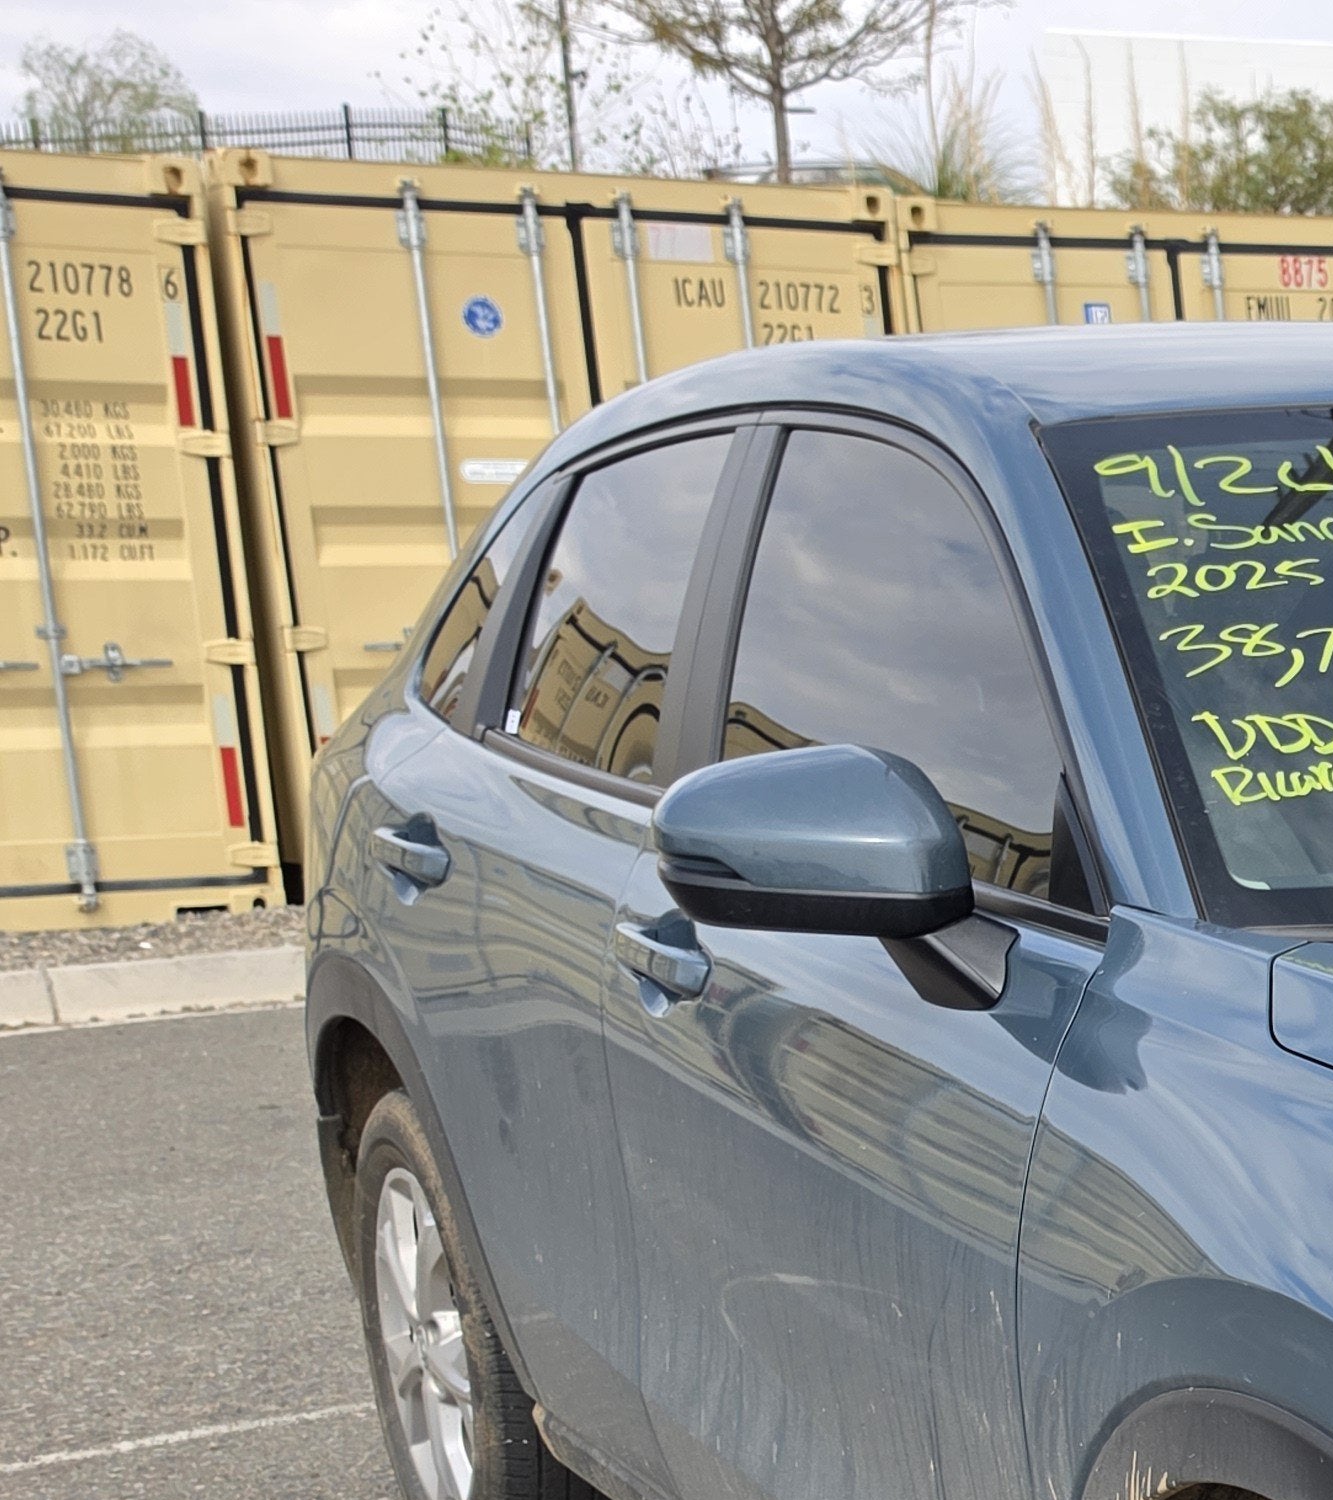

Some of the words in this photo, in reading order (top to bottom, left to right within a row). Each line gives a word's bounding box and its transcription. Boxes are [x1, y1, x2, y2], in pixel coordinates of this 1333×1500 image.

[27, 260, 133, 297] 210778
[164, 269, 178, 300] 6
[674, 277, 726, 308] ICAU
[758, 279, 841, 314] 210772
[35, 307, 103, 343] 22G1
[1146, 559, 1325, 599] 2025
